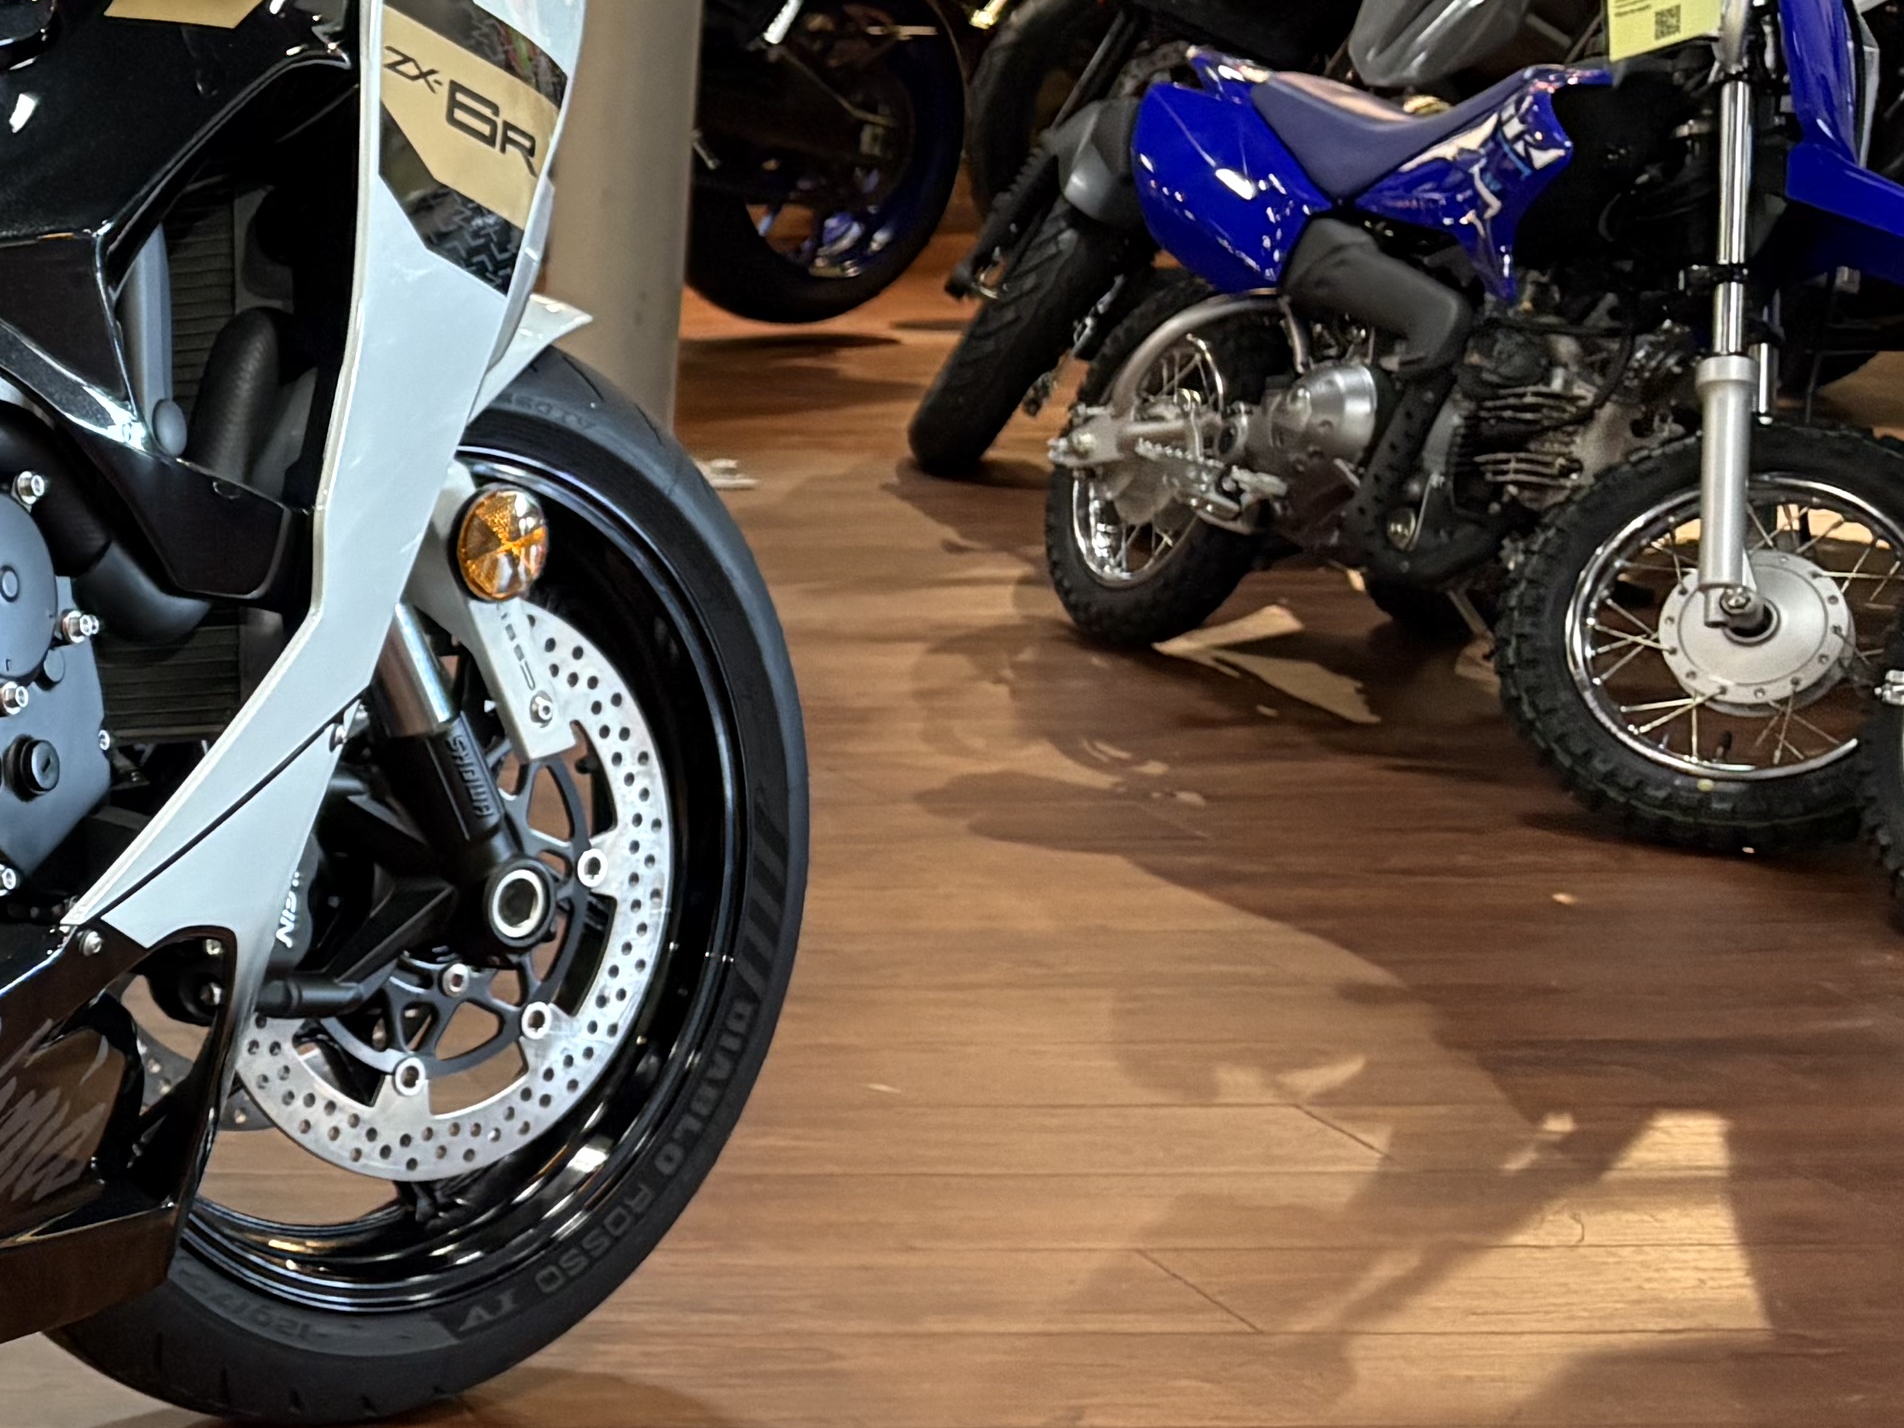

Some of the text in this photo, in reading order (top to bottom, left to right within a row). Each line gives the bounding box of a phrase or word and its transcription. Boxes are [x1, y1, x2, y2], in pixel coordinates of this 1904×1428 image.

[383, 44, 538, 178] ZX-6R
[444, 733, 494, 819] SHOWA
[457, 997, 758, 1333] DIABLO ROSSO IV
